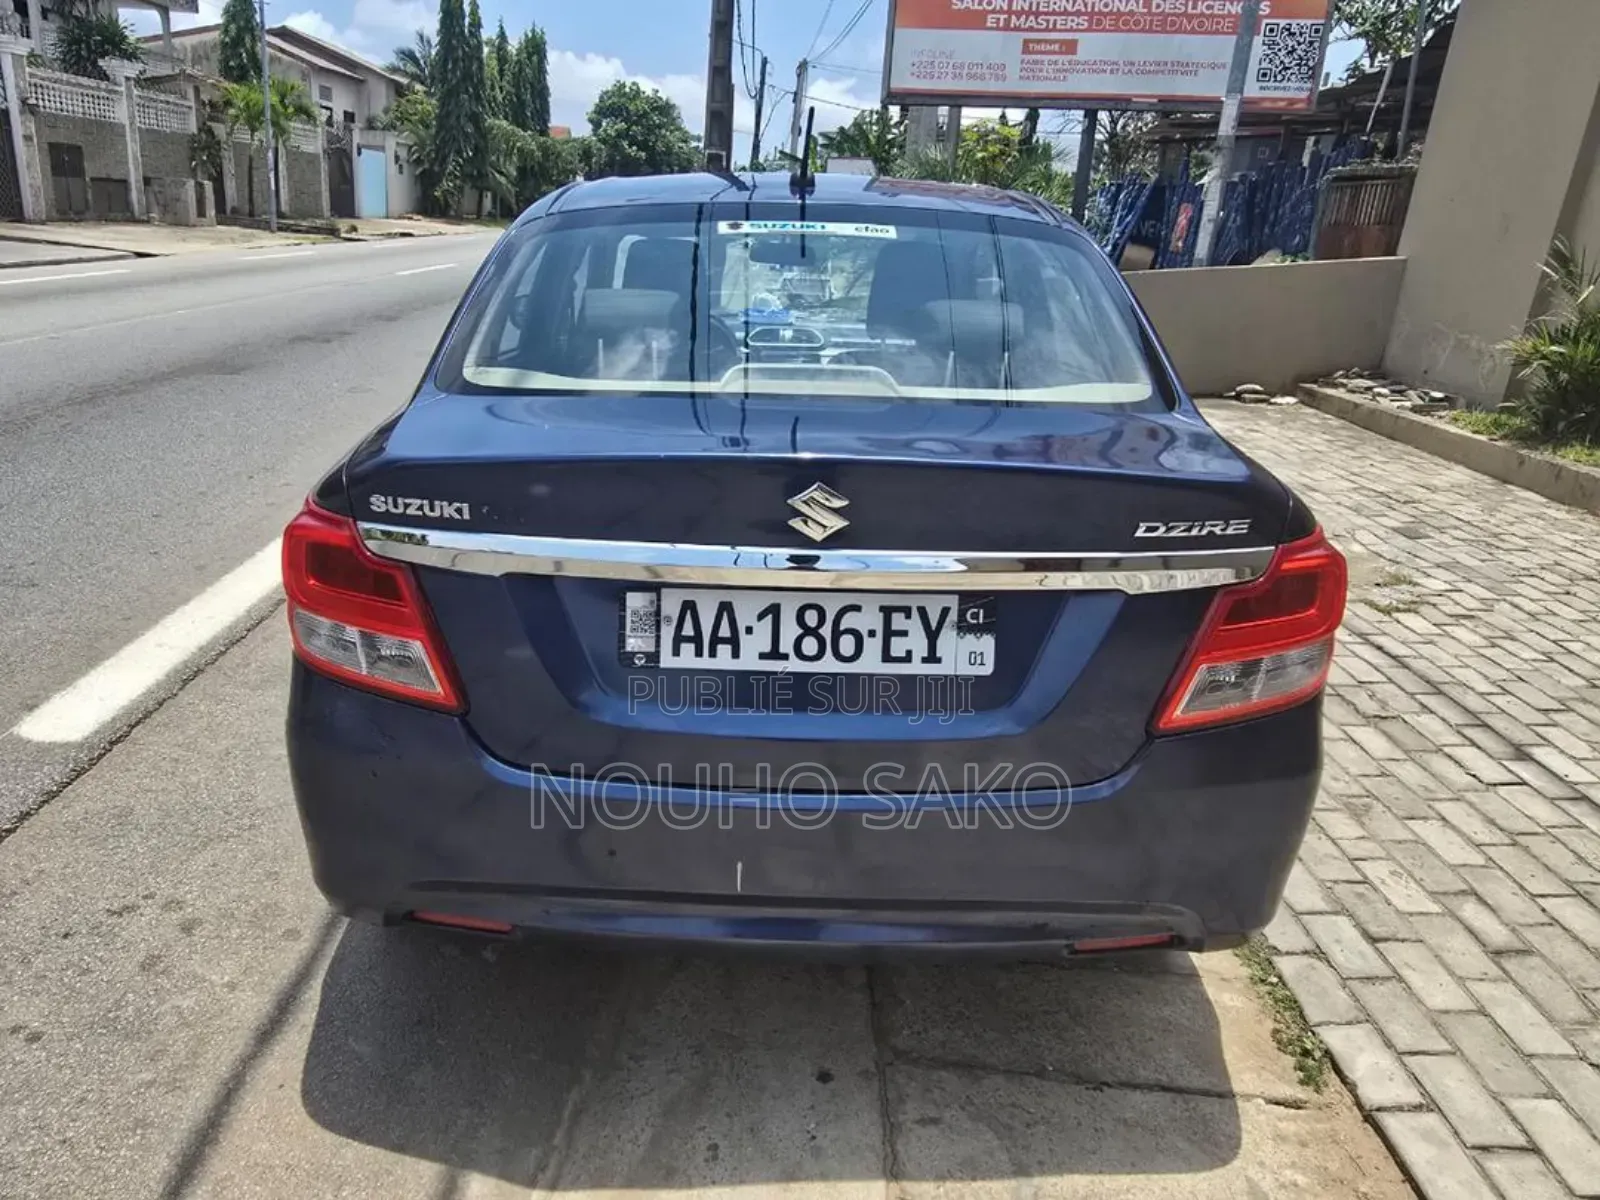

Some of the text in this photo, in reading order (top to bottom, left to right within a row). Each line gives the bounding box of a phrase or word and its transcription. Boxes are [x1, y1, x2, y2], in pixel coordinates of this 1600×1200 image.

[951, 0, 1007, 11] SALON
[1012, 0, 1147, 13] INTERNATIONAL
[1152, 0, 1185, 13] DES
[986, 14, 1236, 32] ET MASTERS DE CÔTE D'IVOIRE
[750, 222, 826, 230] SUZUKI
[369, 494, 470, 520] SUZUKI
[965, 608, 984, 624] CI
[968, 651, 986, 666] 01
